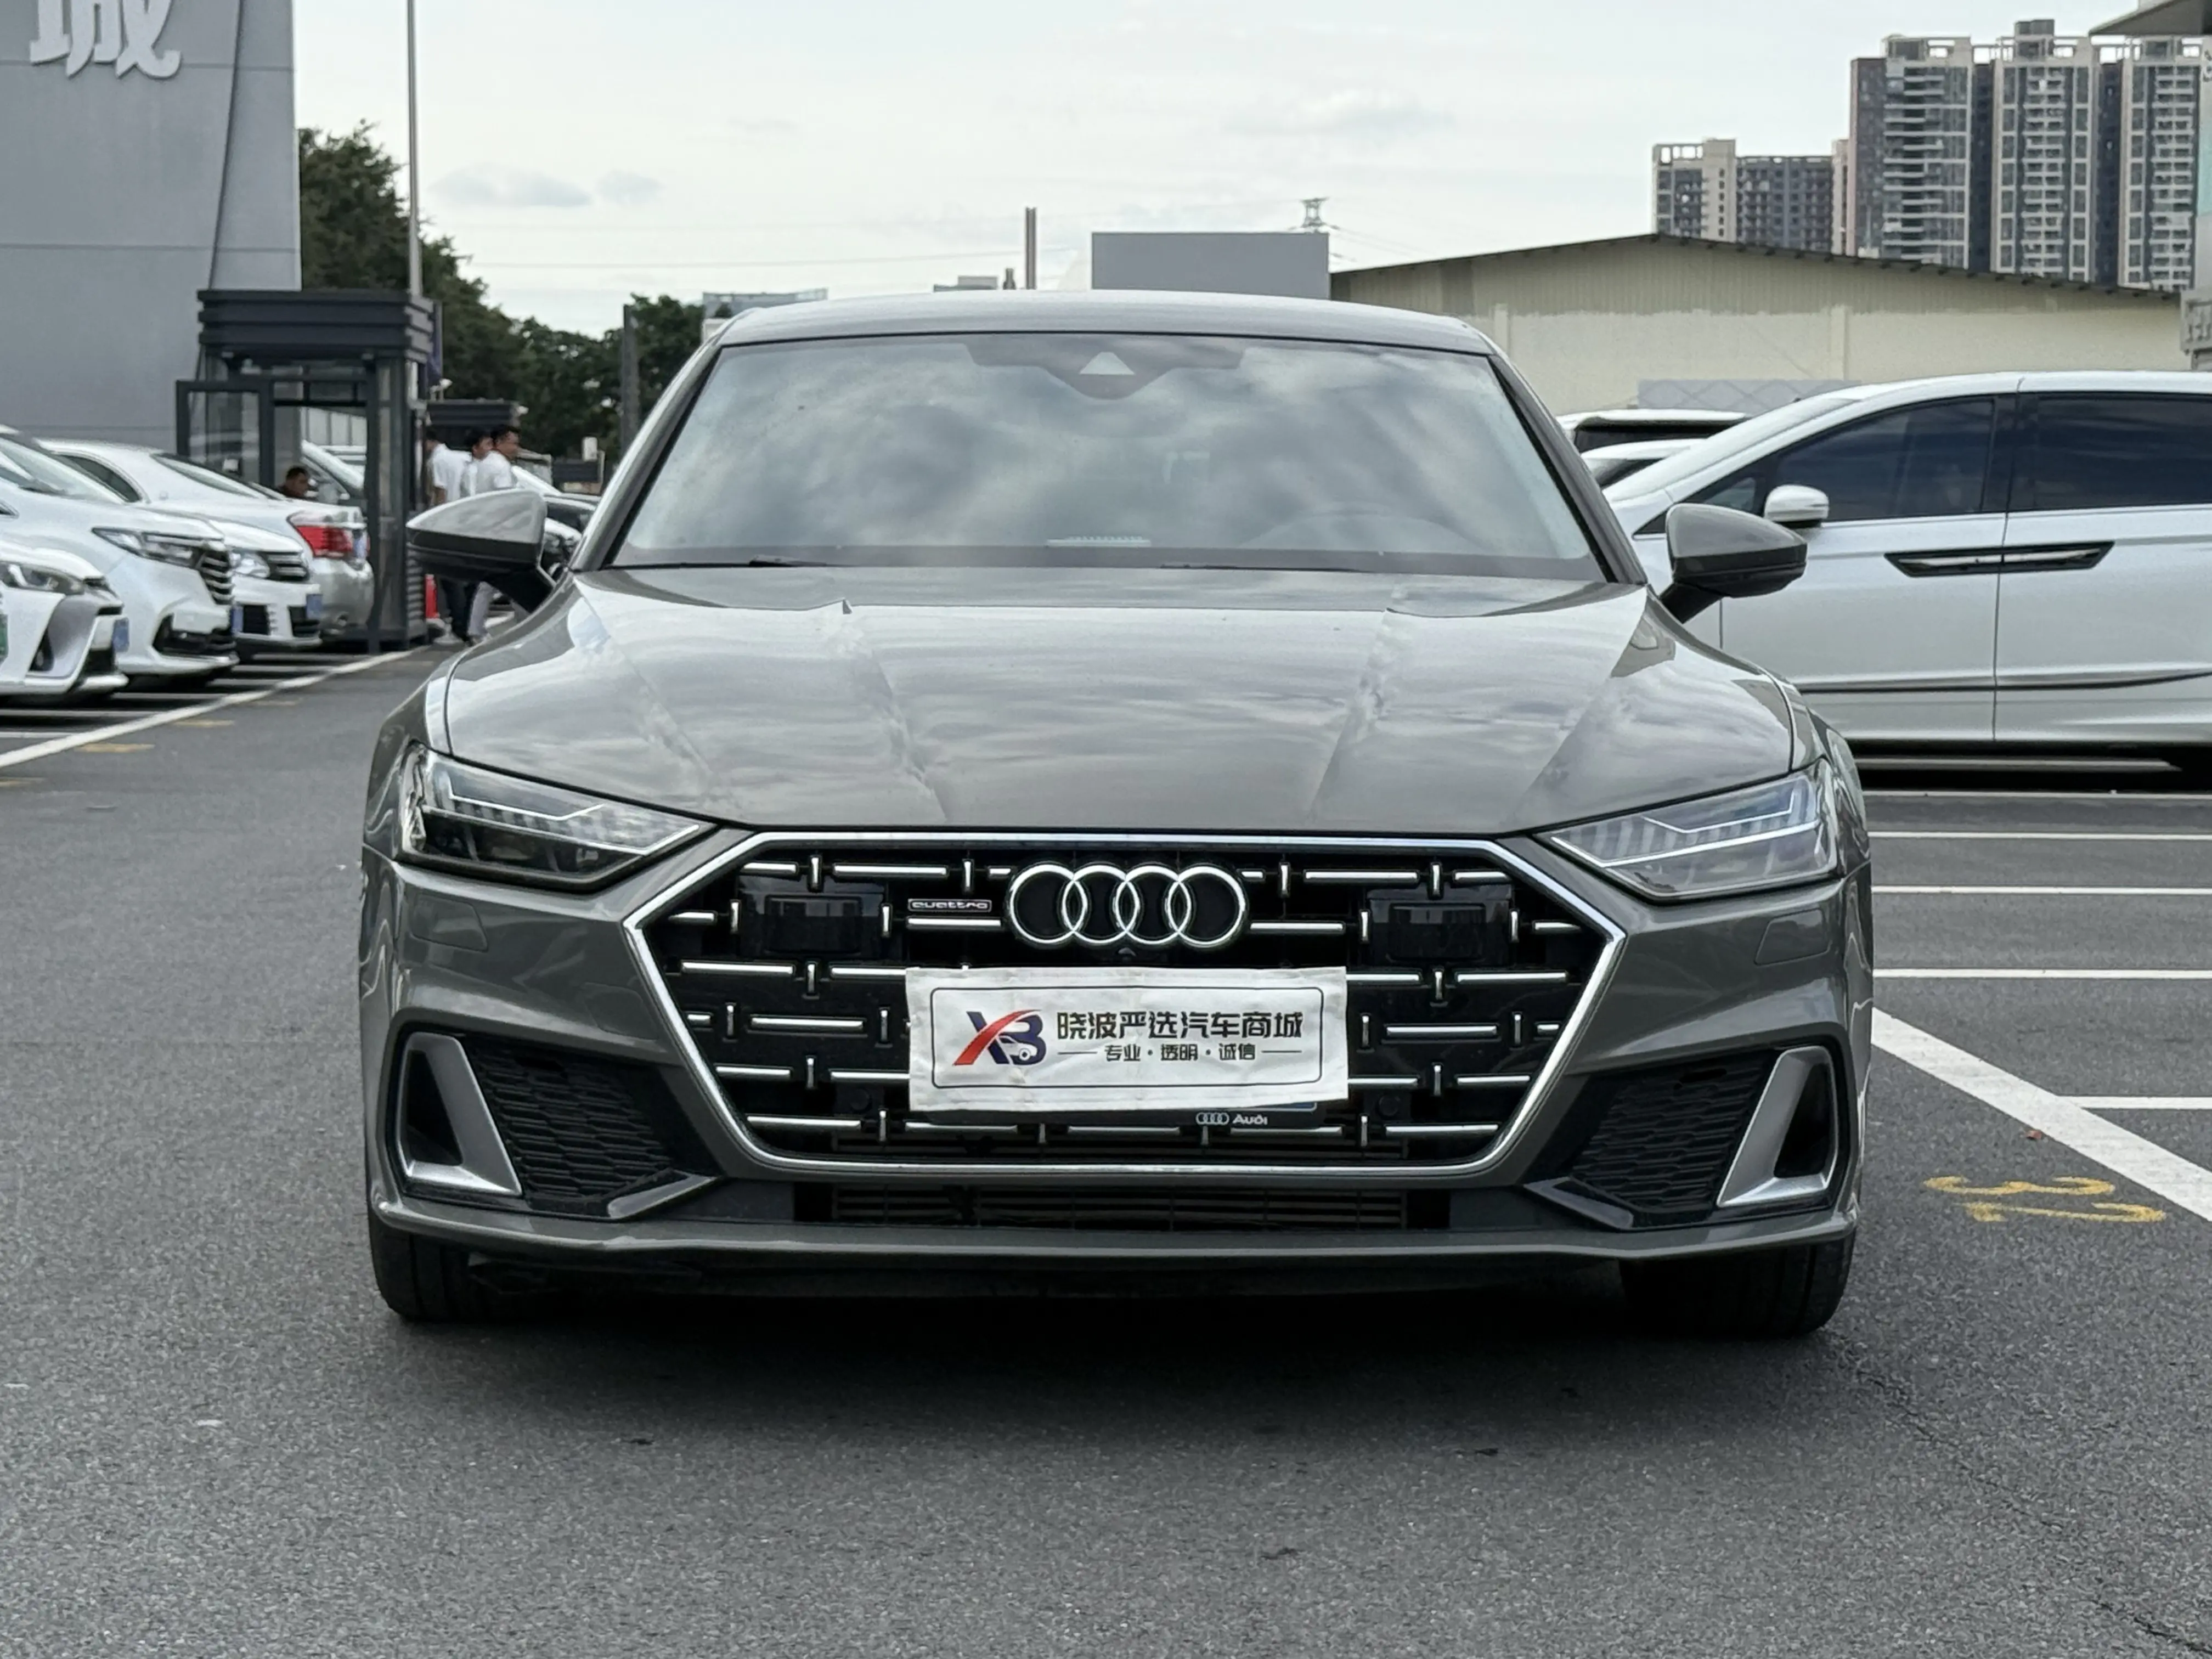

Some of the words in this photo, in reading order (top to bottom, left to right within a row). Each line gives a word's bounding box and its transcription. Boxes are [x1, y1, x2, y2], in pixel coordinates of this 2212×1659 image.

[1057, 1011, 1303, 1039] 晓波严选汽车商城
[1232, 1114, 1268, 1125] Audi
